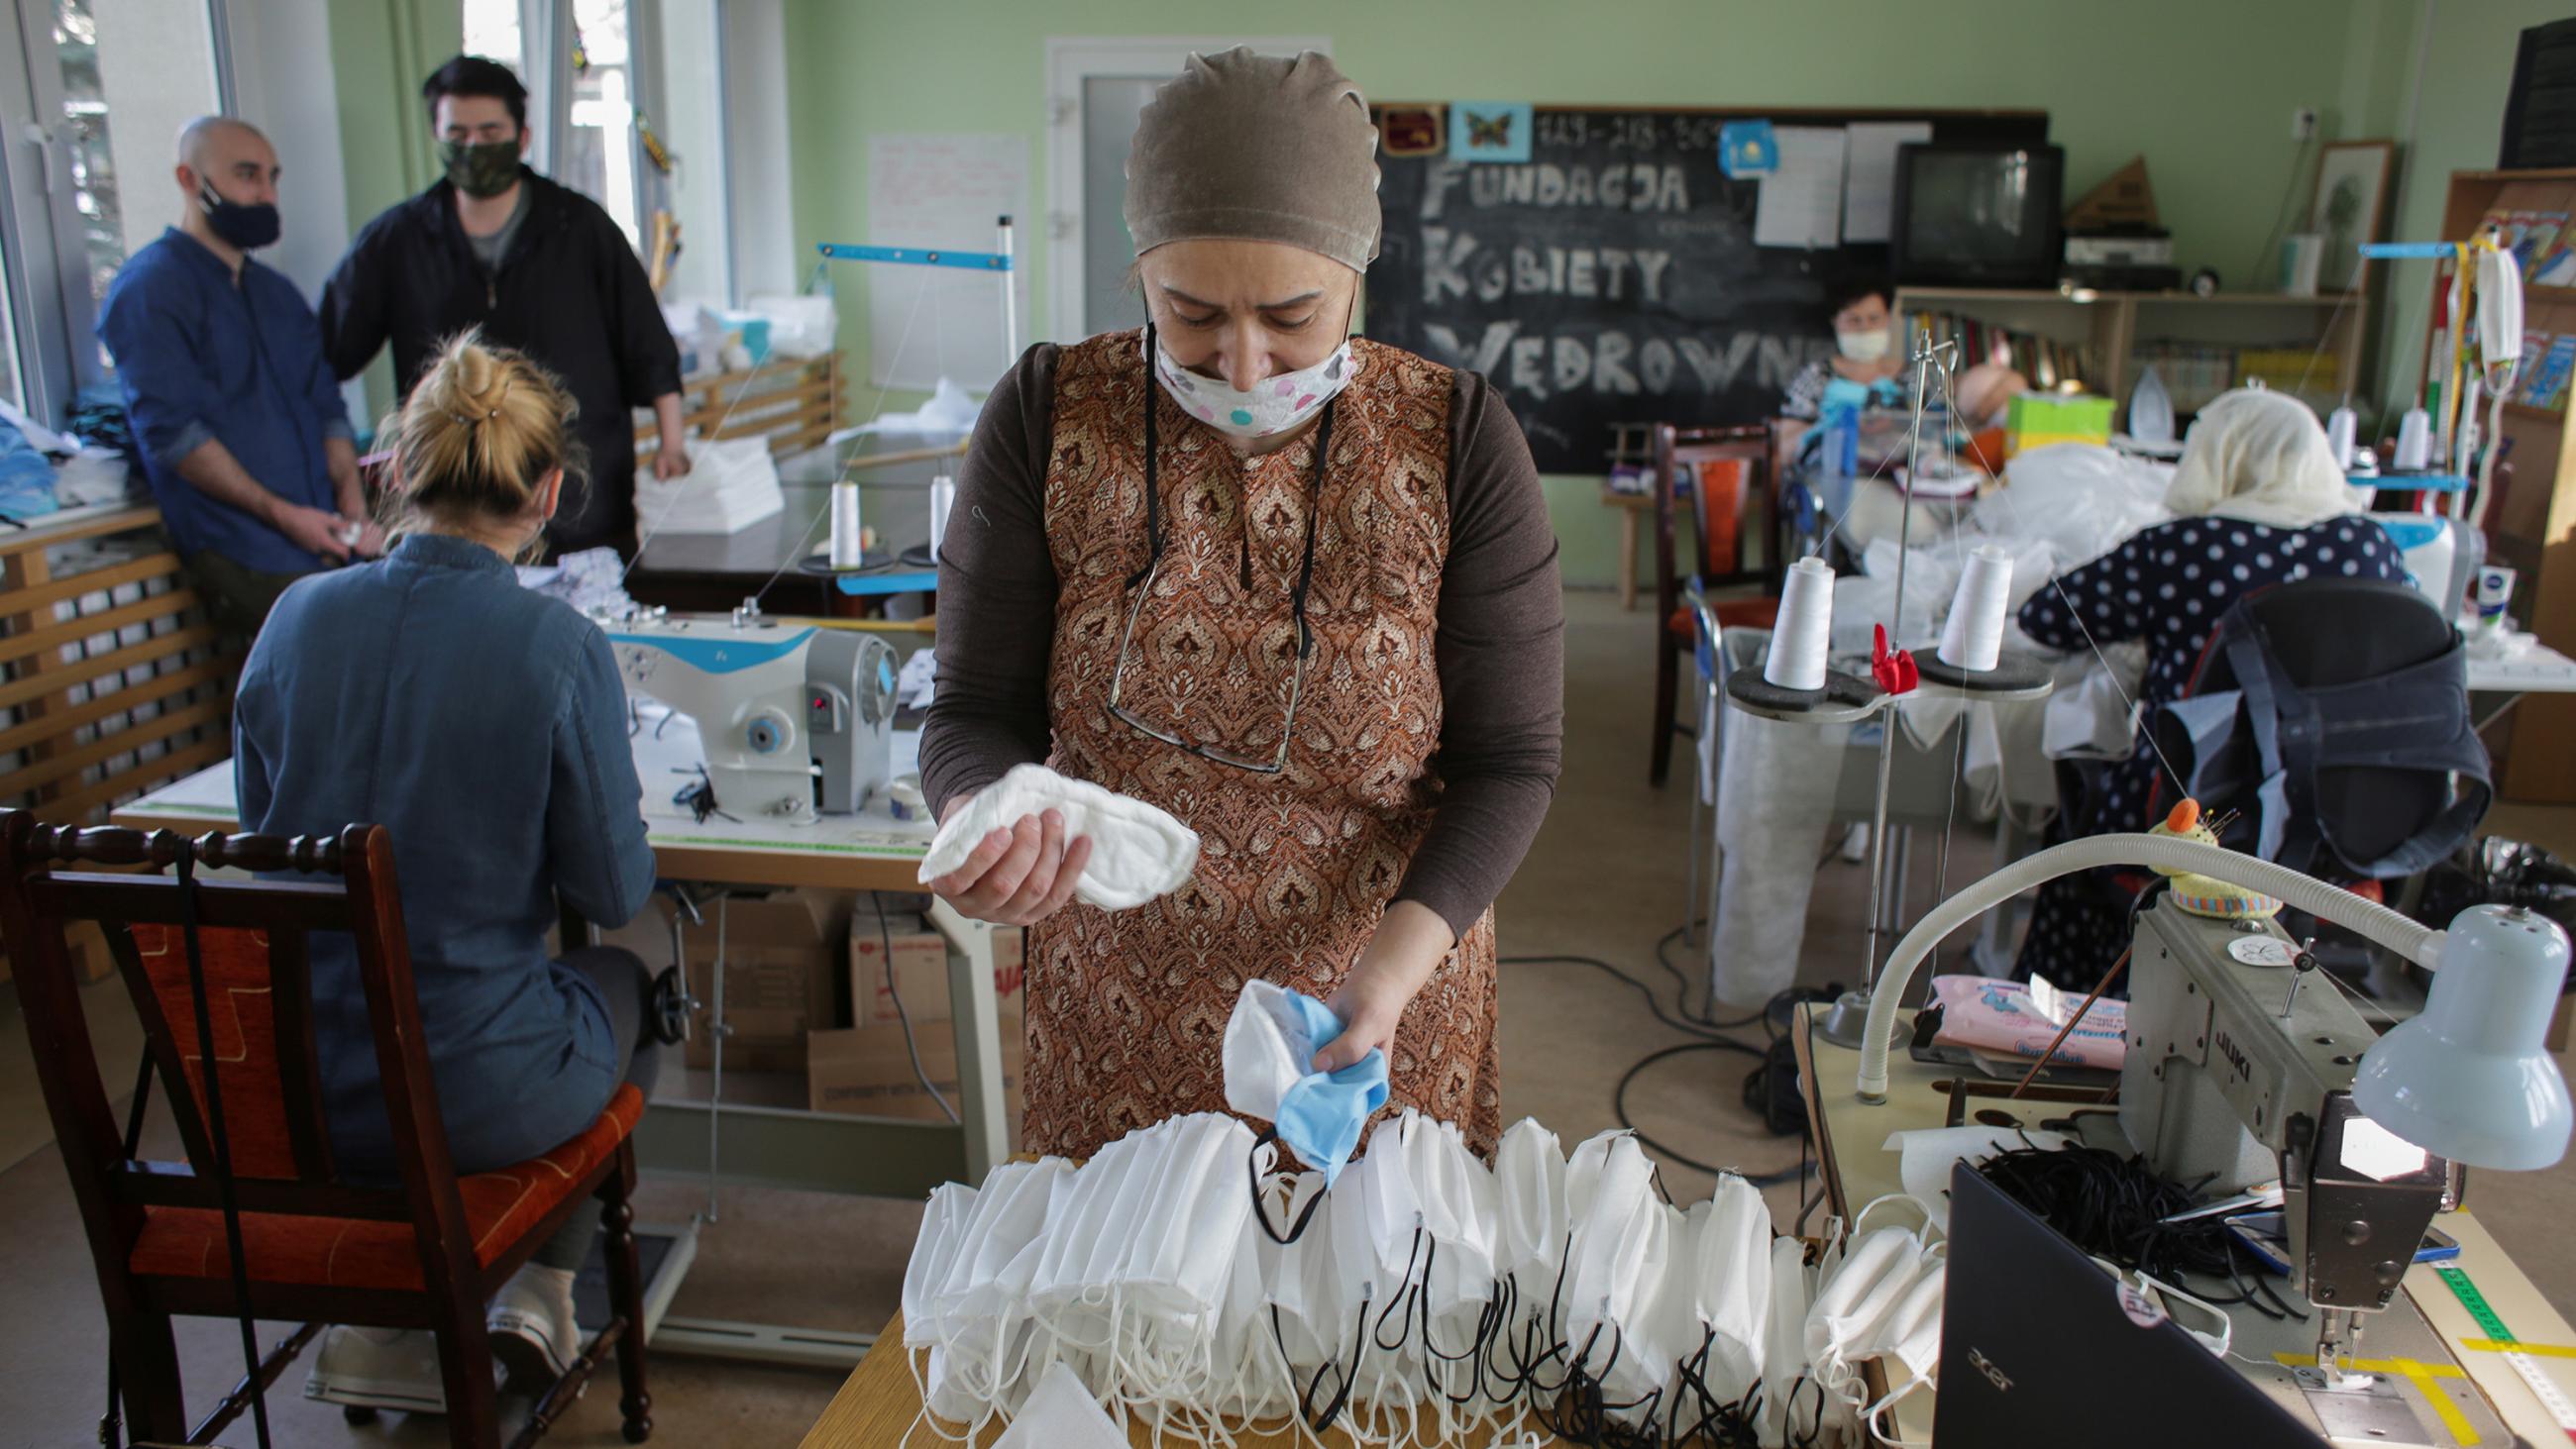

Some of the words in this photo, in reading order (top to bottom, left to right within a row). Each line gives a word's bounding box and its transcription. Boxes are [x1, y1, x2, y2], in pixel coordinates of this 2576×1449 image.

[1420, 158, 1689, 220] FUNDACJA
[1420, 225, 1672, 304] KOBIETY
[2215, 1031, 2251, 1083] JUKI
[1968, 1347, 2014, 1392] acer
